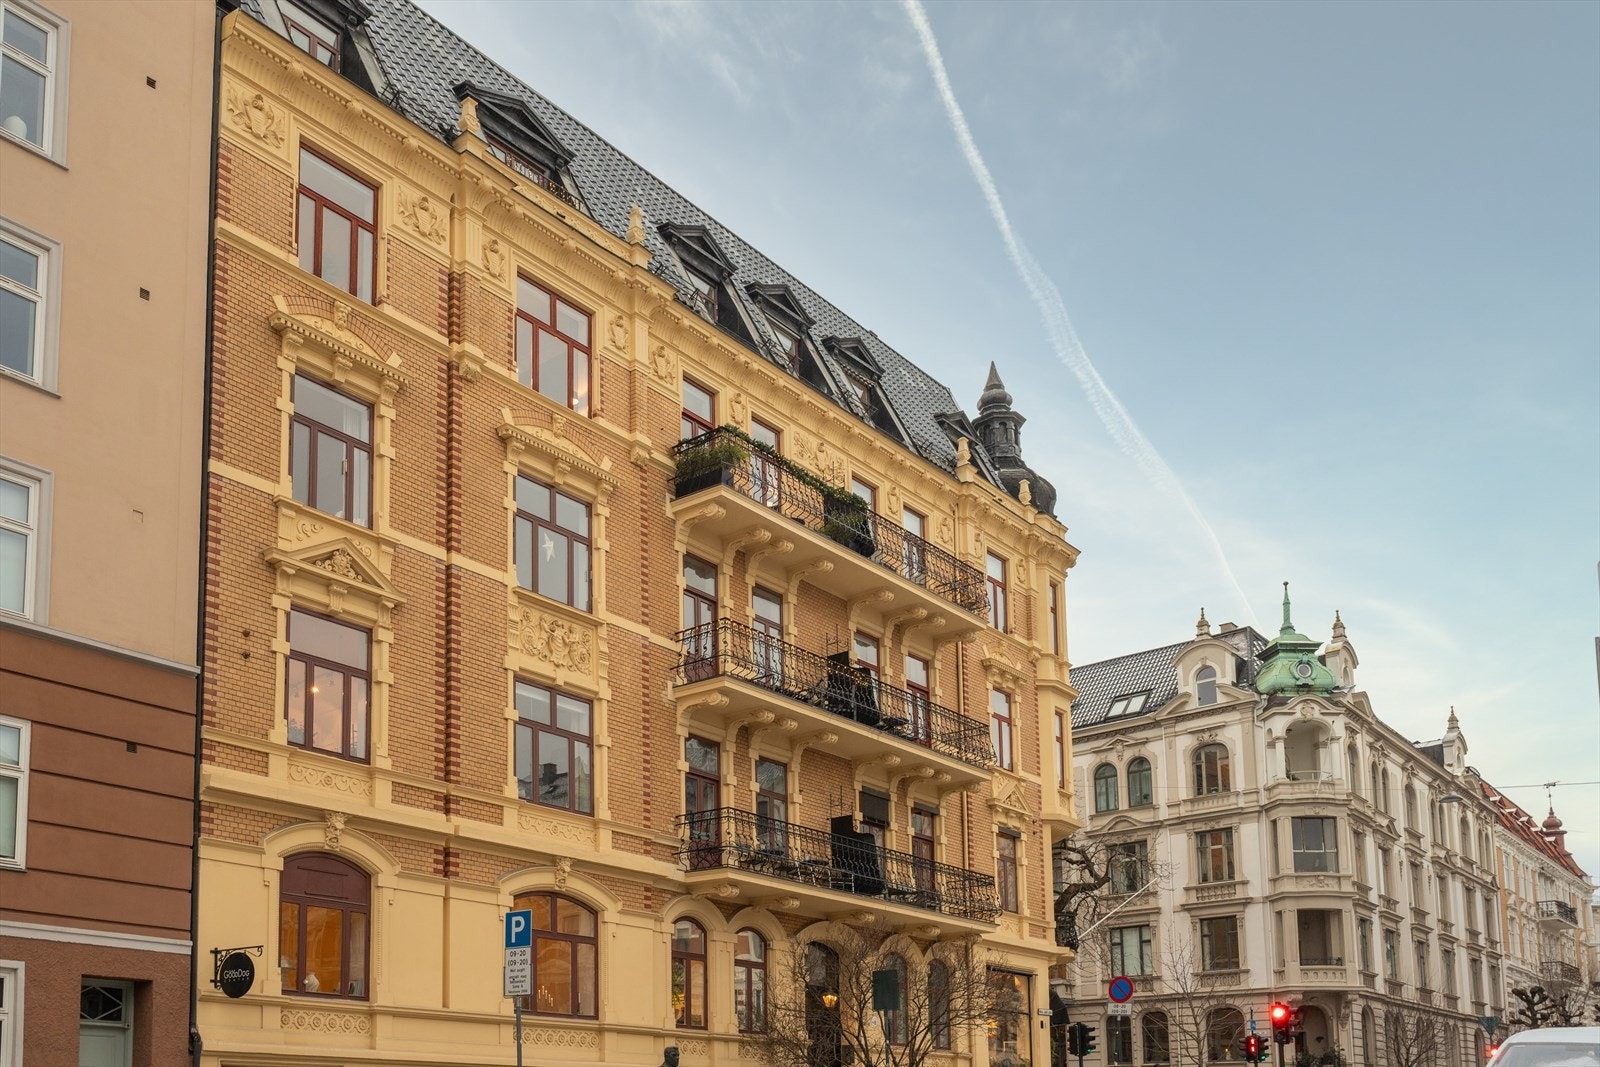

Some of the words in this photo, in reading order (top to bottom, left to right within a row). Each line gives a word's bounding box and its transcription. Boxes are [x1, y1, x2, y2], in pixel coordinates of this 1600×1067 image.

[511, 916, 525, 943] P
[509, 950, 527, 958] 09-20
[507, 958, 529, 967] (09-20)
